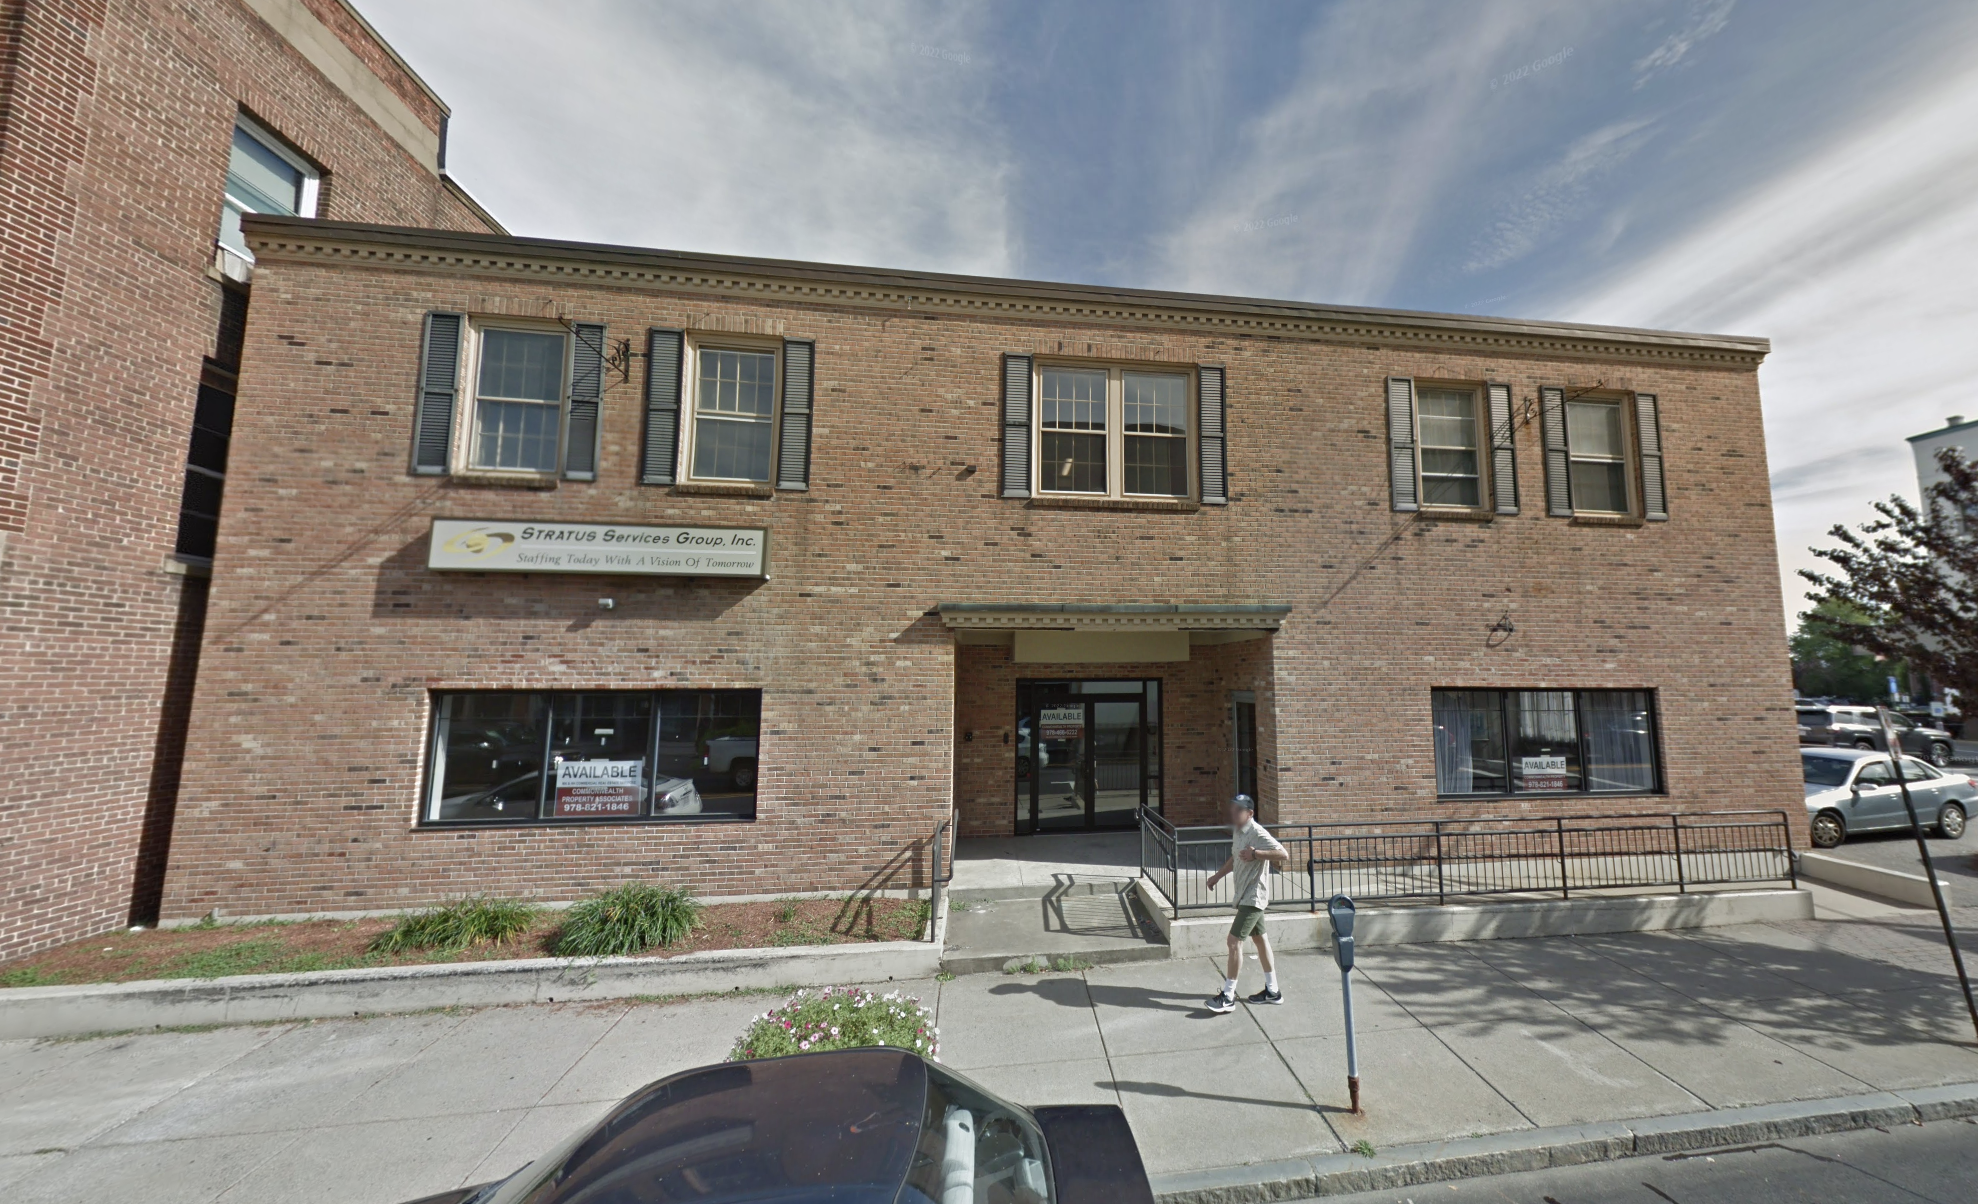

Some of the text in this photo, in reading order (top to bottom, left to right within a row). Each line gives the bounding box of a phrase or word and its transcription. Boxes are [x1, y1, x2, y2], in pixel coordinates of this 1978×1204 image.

[520, 527, 756, 547] STRATUS Services Group, Inc.
[516, 552, 755, 569] Staffing Today With A Vision Of Tomorrow
[1042, 712, 1081, 720] AVAILABLE
[1524, 760, 1565, 770] AVAILABLE
[562, 765, 637, 779] AVAILABLE
[571, 787, 624, 795] COMMONWEALTH
[563, 803, 629, 811] 978-821-1846
